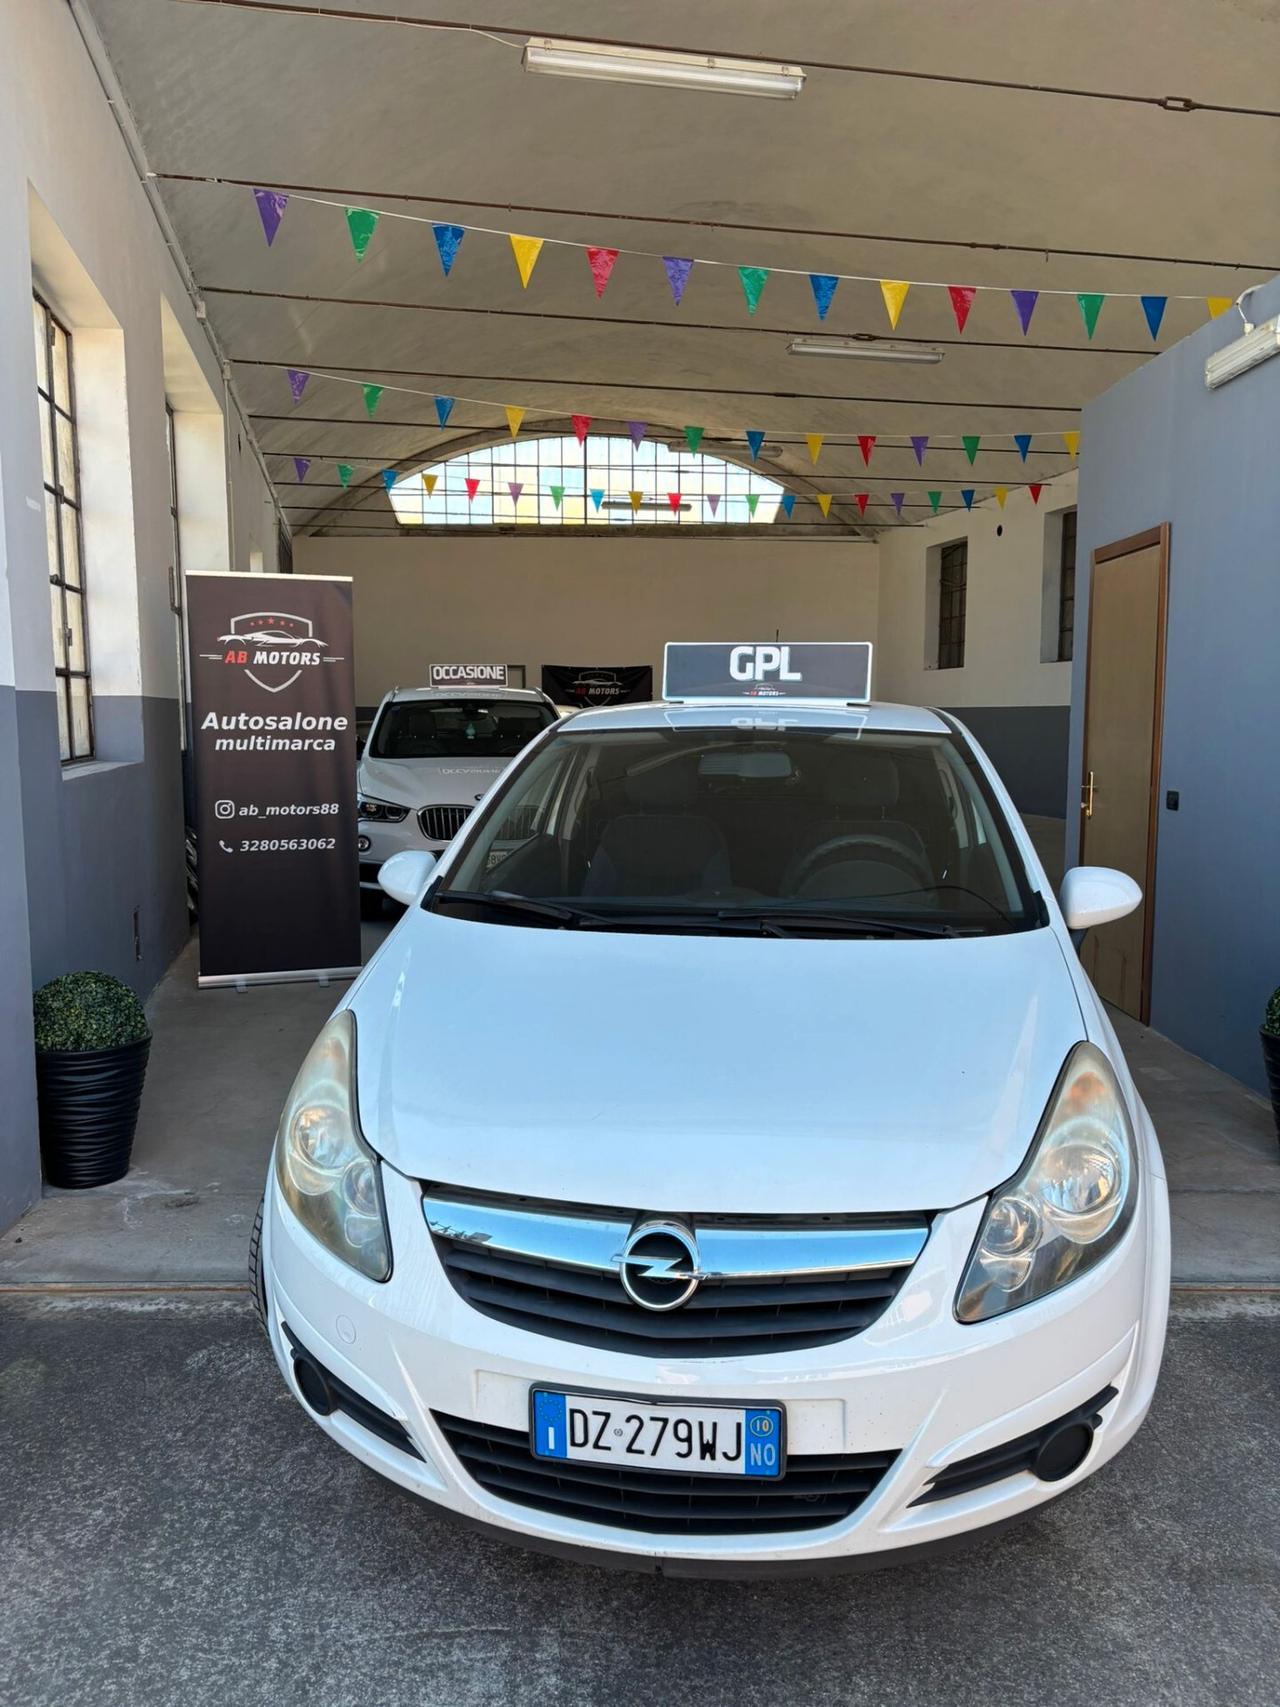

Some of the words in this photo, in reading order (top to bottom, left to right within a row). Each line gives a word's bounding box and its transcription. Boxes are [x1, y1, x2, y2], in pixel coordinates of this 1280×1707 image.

[225, 650, 248, 664] AB
[253, 652, 321, 666] MOTORS
[729, 646, 802, 682] GPL
[433, 666, 504, 680] OCCASIONE
[588, 687, 620, 695] MOTORS
[201, 711, 348, 730] Autosalone
[215, 735, 336, 750] multimarca
[239, 803, 339, 818] ab_motors88
[240, 838, 336, 852] 3280563062
[750, 1443, 776, 1466] NO
